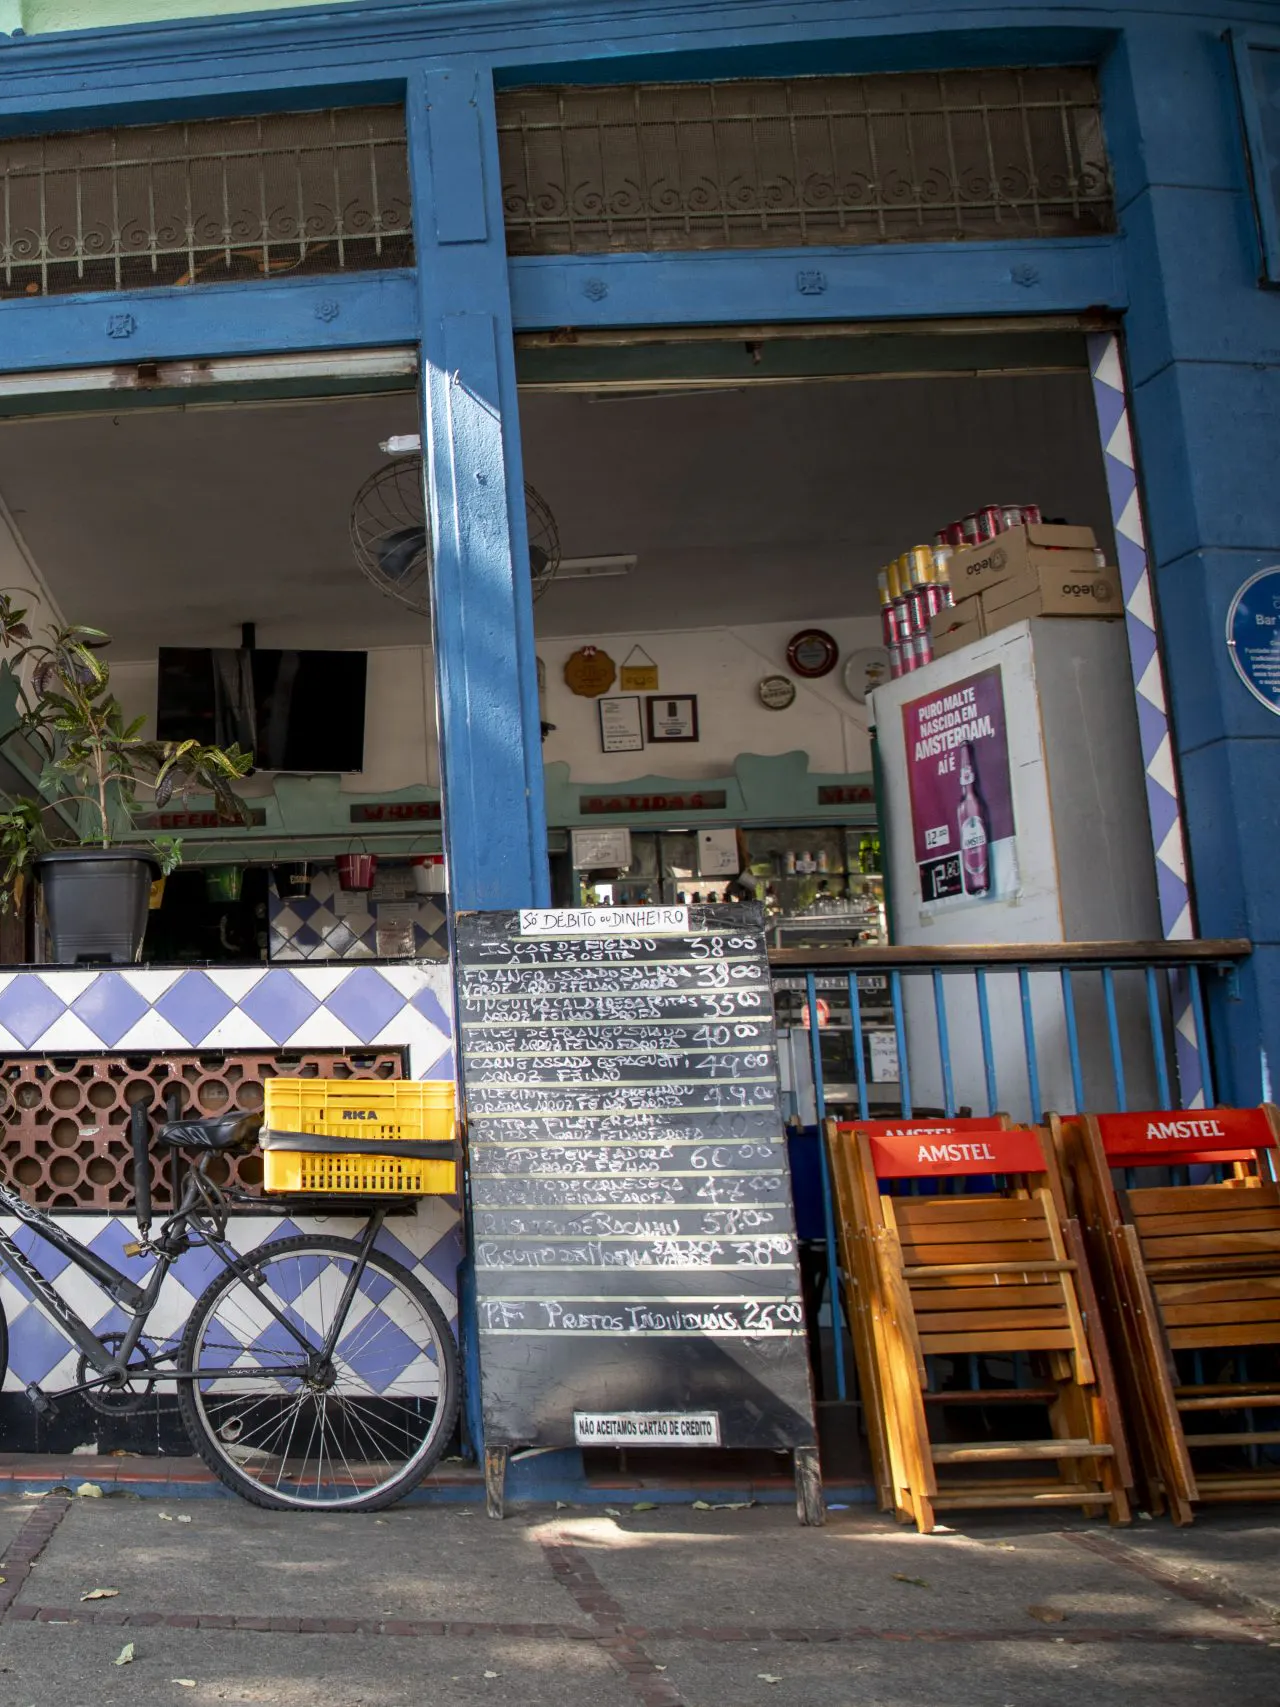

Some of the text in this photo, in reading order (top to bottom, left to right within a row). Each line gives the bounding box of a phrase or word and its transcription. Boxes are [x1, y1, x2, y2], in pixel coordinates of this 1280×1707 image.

[1255, 613, 1277, 626] Bar
[918, 686, 976, 722] PURO MALTE
[920, 703, 979, 738] NASCIDA EM
[914, 715, 996, 762] AMSTERDAM,
[948, 752, 957, 772] É
[540, 911, 596, 930] DÉBITO
[611, 911, 683, 929] DINHEIRO
[480, 942, 551, 956] ISCAS
[470, 1057, 528, 1071] CARNE
[531, 1056, 593, 1069] ASSADA
[342, 1110, 378, 1120] RICA
[1146, 1119, 1225, 1141] AMSTEL
[917, 1143, 996, 1164] AMSTEL
[540, 1303, 624, 1331] PRATOS
[579, 1417, 594, 1435] NÃO
[596, 1419, 637, 1436] ACEITAMOS
[669, 1420, 680, 1436] DE
